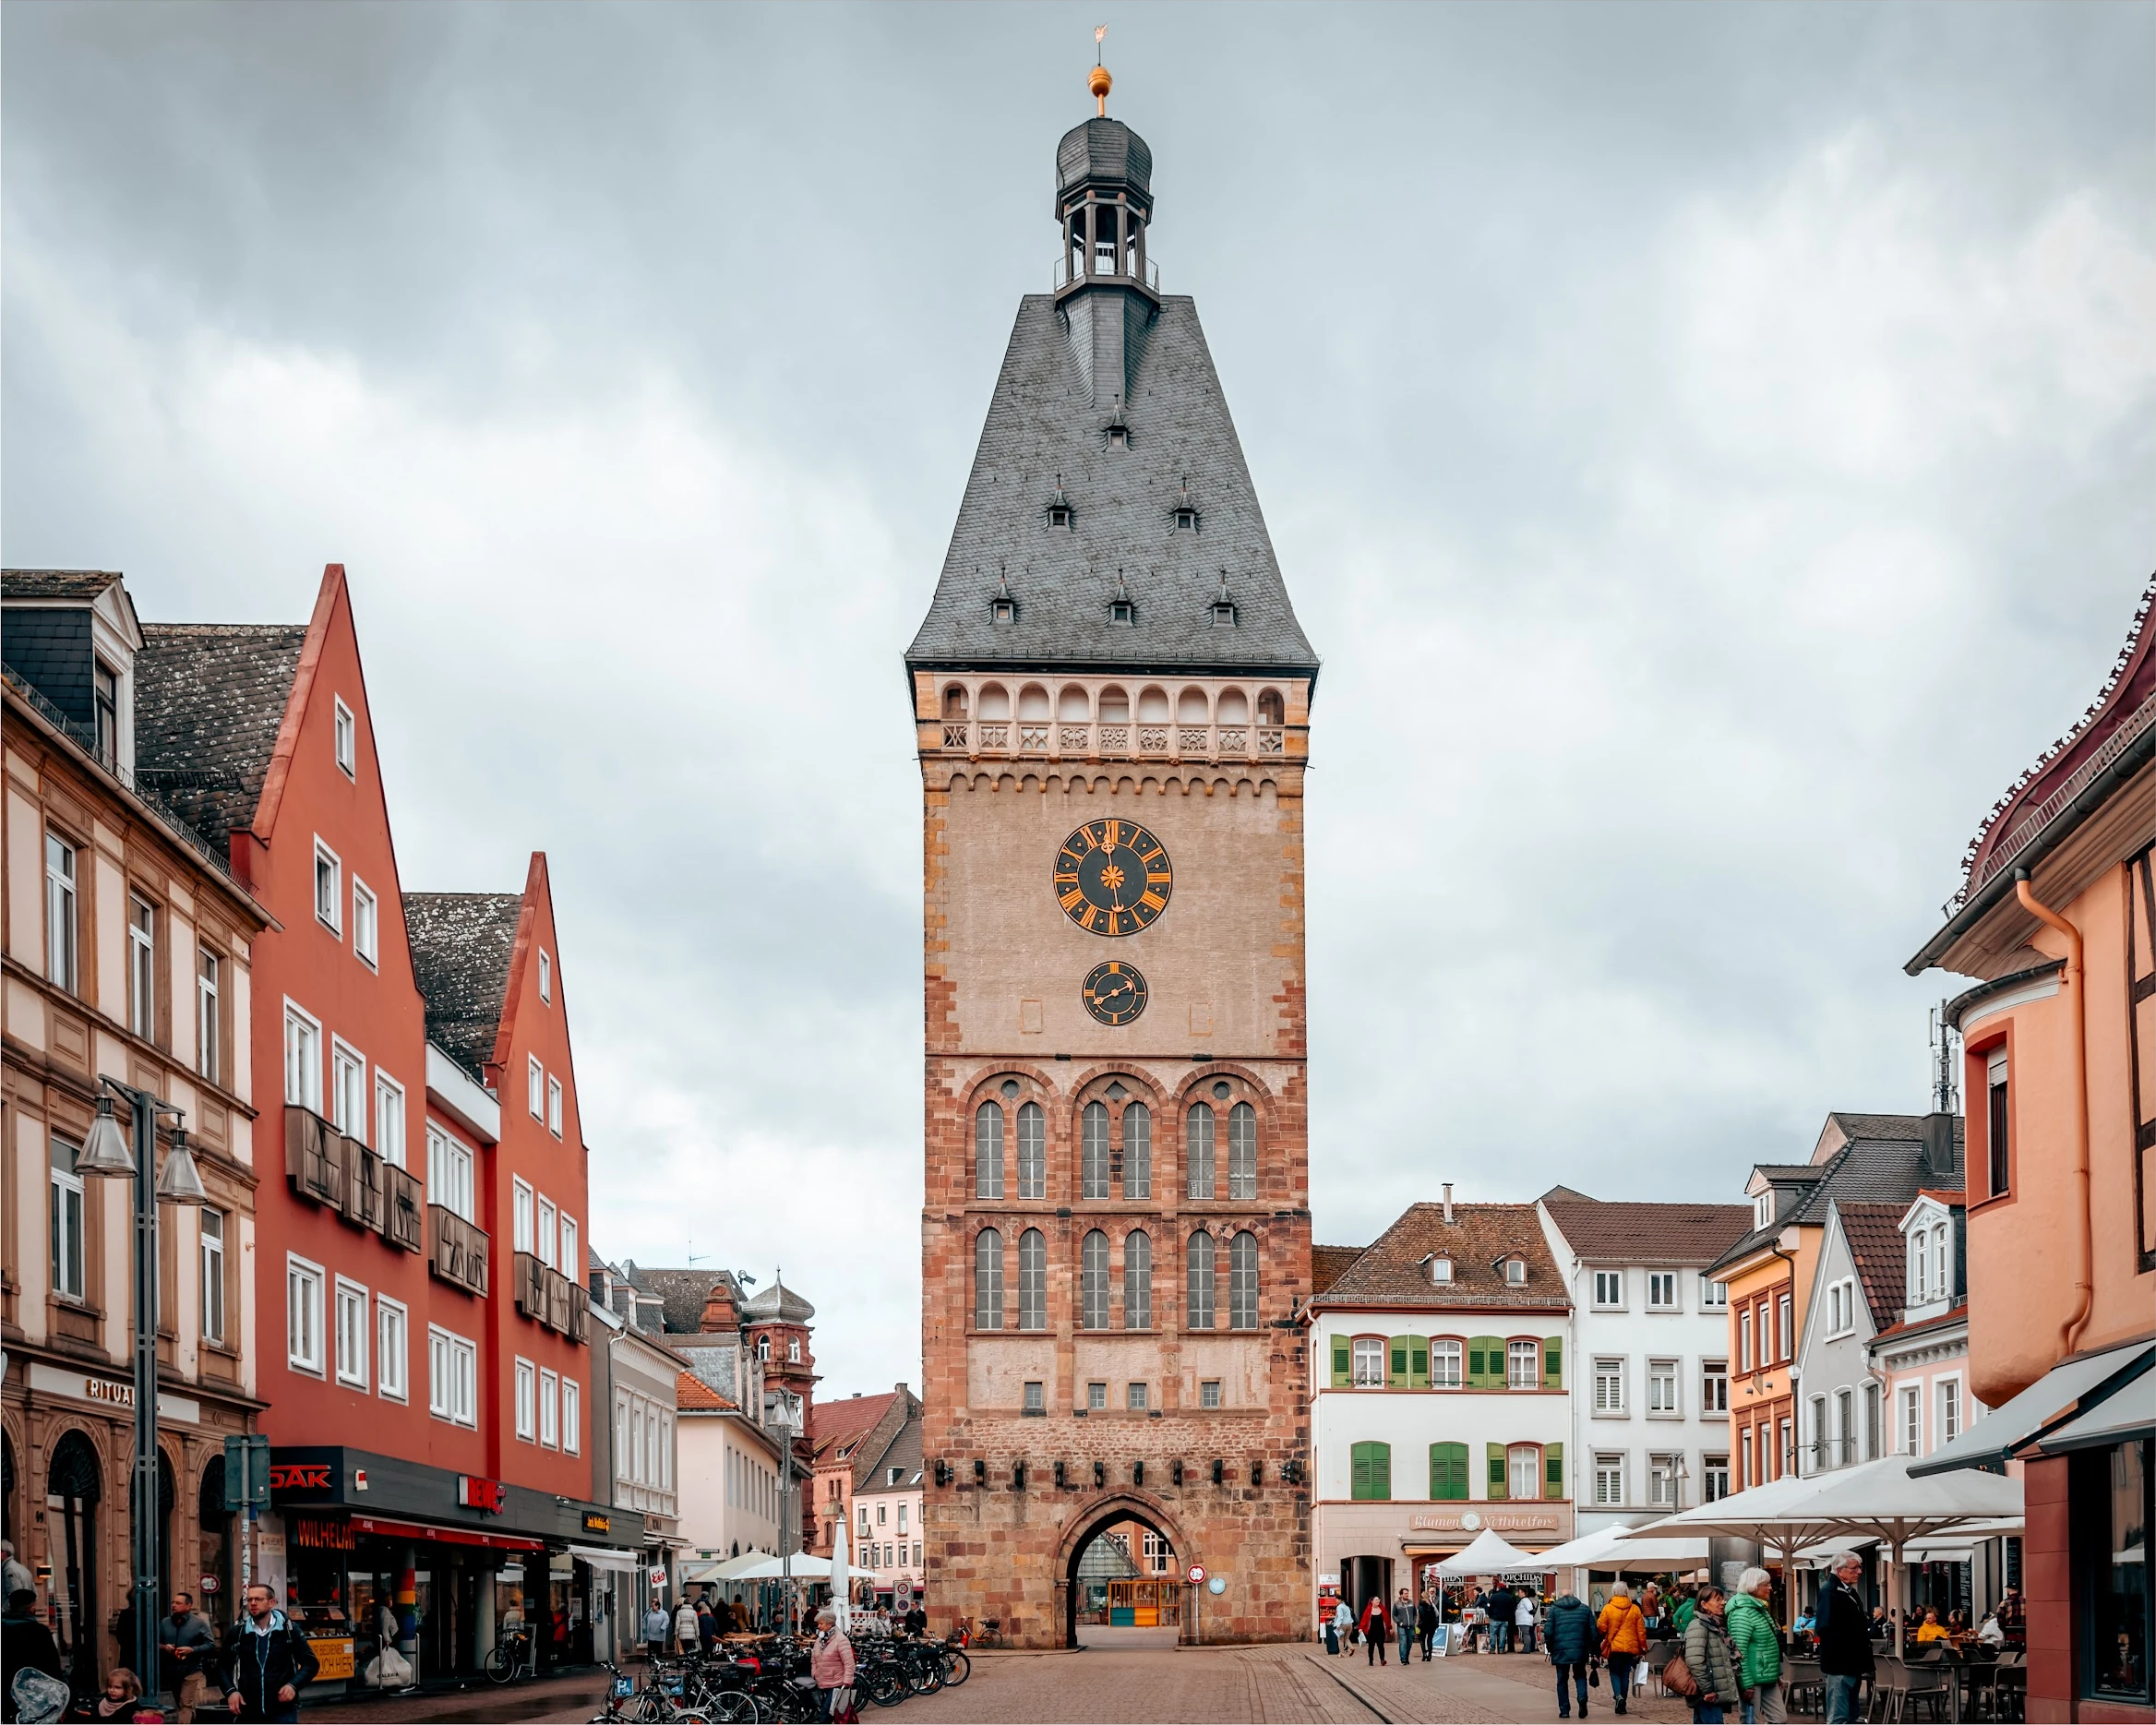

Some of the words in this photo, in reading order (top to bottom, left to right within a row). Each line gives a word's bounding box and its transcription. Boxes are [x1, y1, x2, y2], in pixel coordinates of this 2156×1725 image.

[1061, 845, 1083, 862] X
[1142, 846, 1163, 863] II
[1147, 872, 1170, 883] III
[1130, 908, 1145, 928] V
[90, 1379, 136, 1405] RITUAL
[1414, 1515, 1459, 1527] Blumen
[1482, 1515, 1555, 1527] Nothhelfer
[652, 1570, 665, 1584] Eis
[1503, 1573, 1541, 1584] ORCHIDS
[319, 1659, 333, 1674] UCH
[617, 1680, 627, 1693] P
